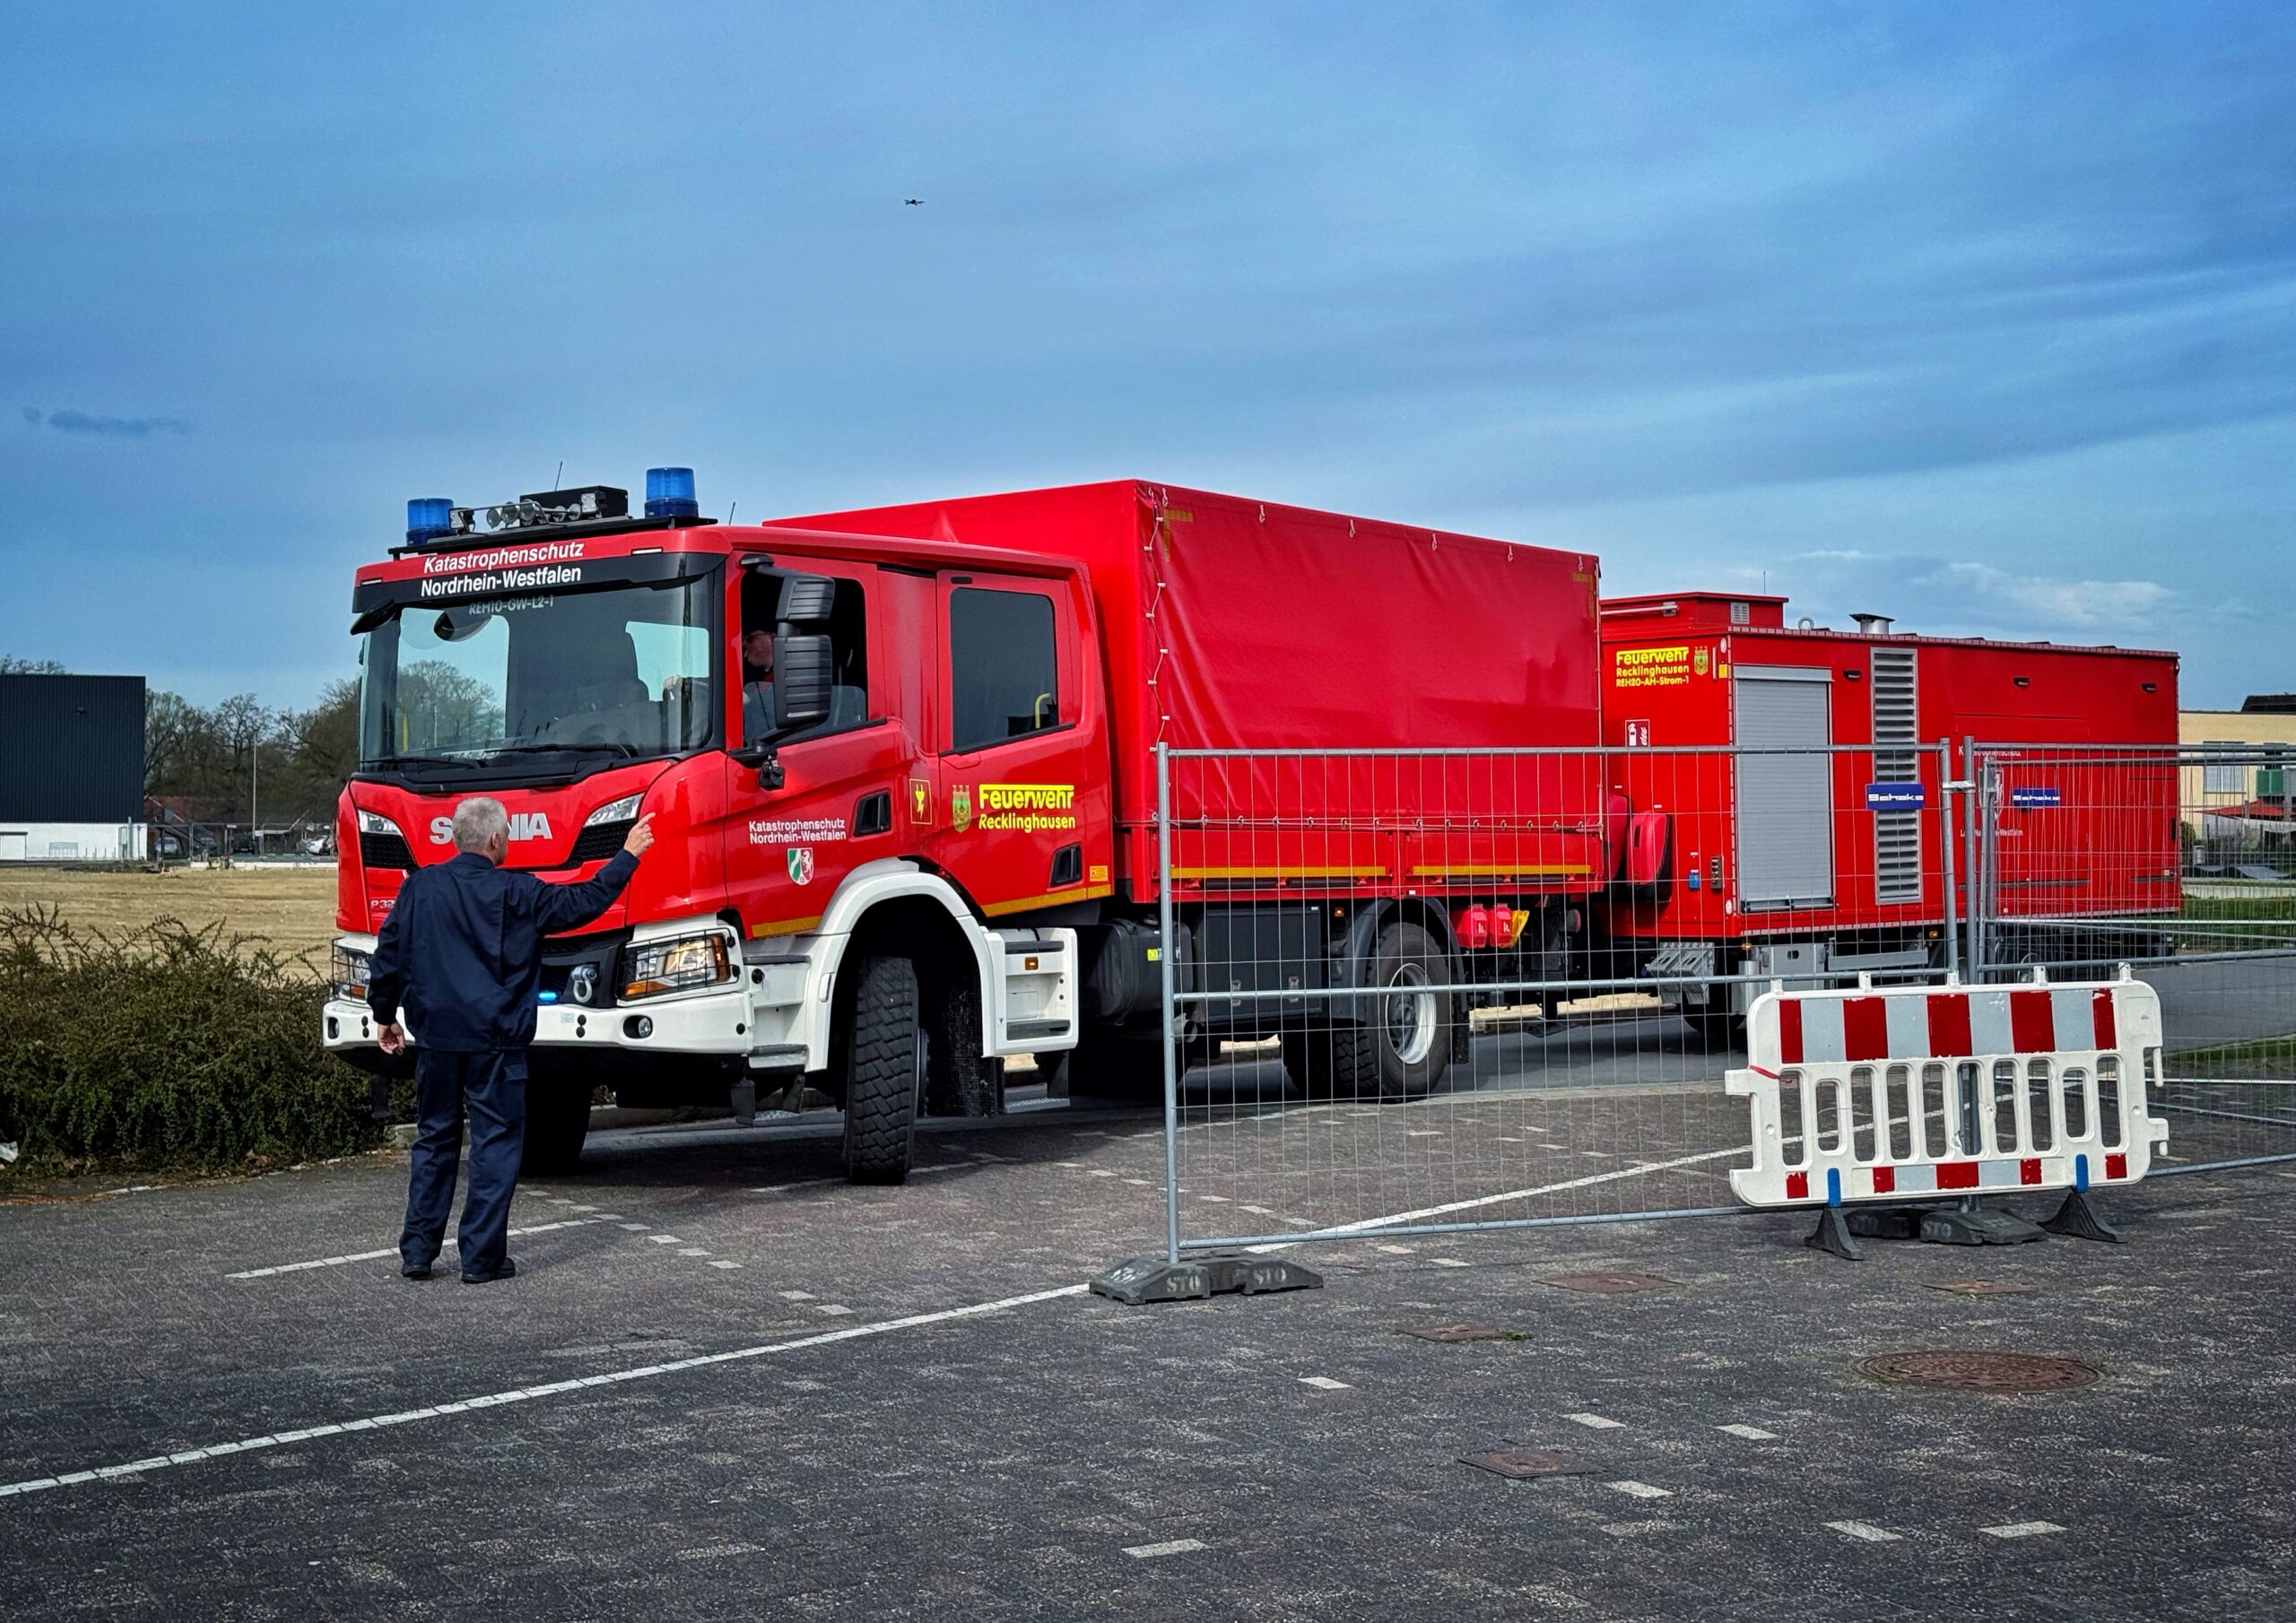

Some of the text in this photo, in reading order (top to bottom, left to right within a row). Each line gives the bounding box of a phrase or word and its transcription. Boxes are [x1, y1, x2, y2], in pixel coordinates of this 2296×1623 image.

[423, 541, 585, 574] Katastrophenschutz
[421, 566, 581, 597] Nordrhein-Westfalen
[1616, 647, 1689, 665] Feuerwehr
[1616, 664, 1689, 677] Recklinghausen
[979, 784, 1074, 809] Feuerwehr
[749, 818, 845, 833] Katastrophenschutz
[978, 812, 1075, 833] Recklinghausen
[750, 829, 847, 845] Nordrhein-Westfalen
